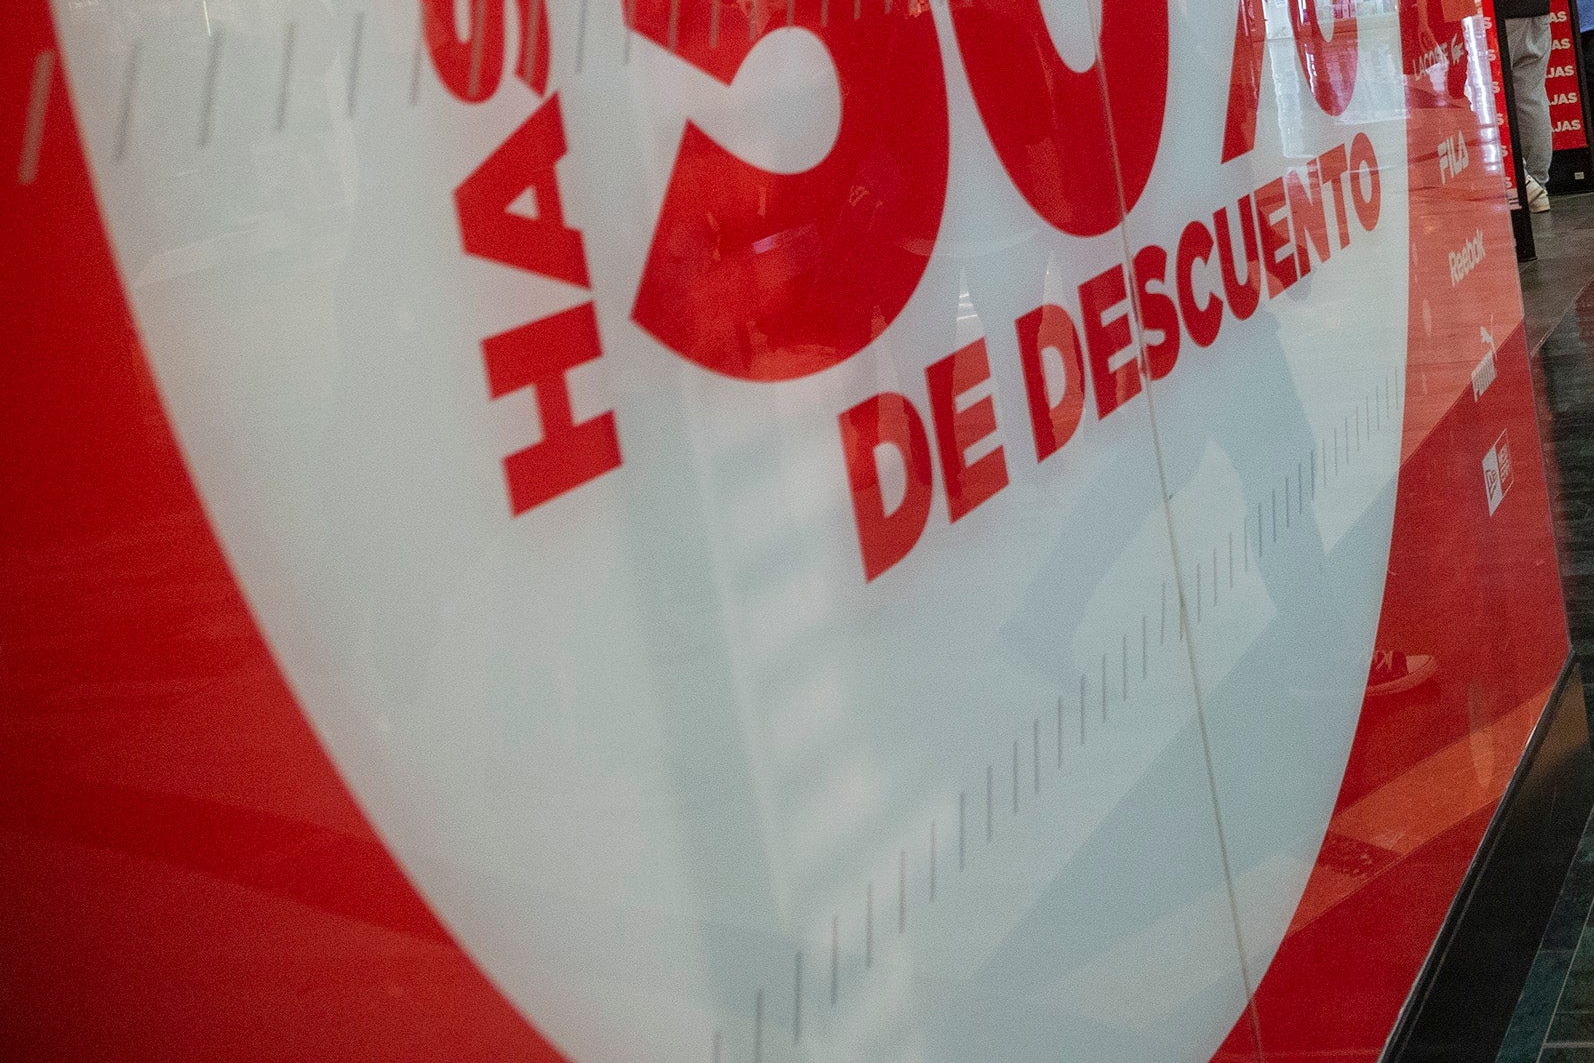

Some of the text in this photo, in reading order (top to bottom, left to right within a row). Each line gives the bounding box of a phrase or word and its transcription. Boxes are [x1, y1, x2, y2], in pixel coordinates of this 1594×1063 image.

[1437, 129, 1469, 185] FILA
[1448, 228, 1486, 287] Reebok
[837, 130, 1380, 584] DE DESCUENTO
